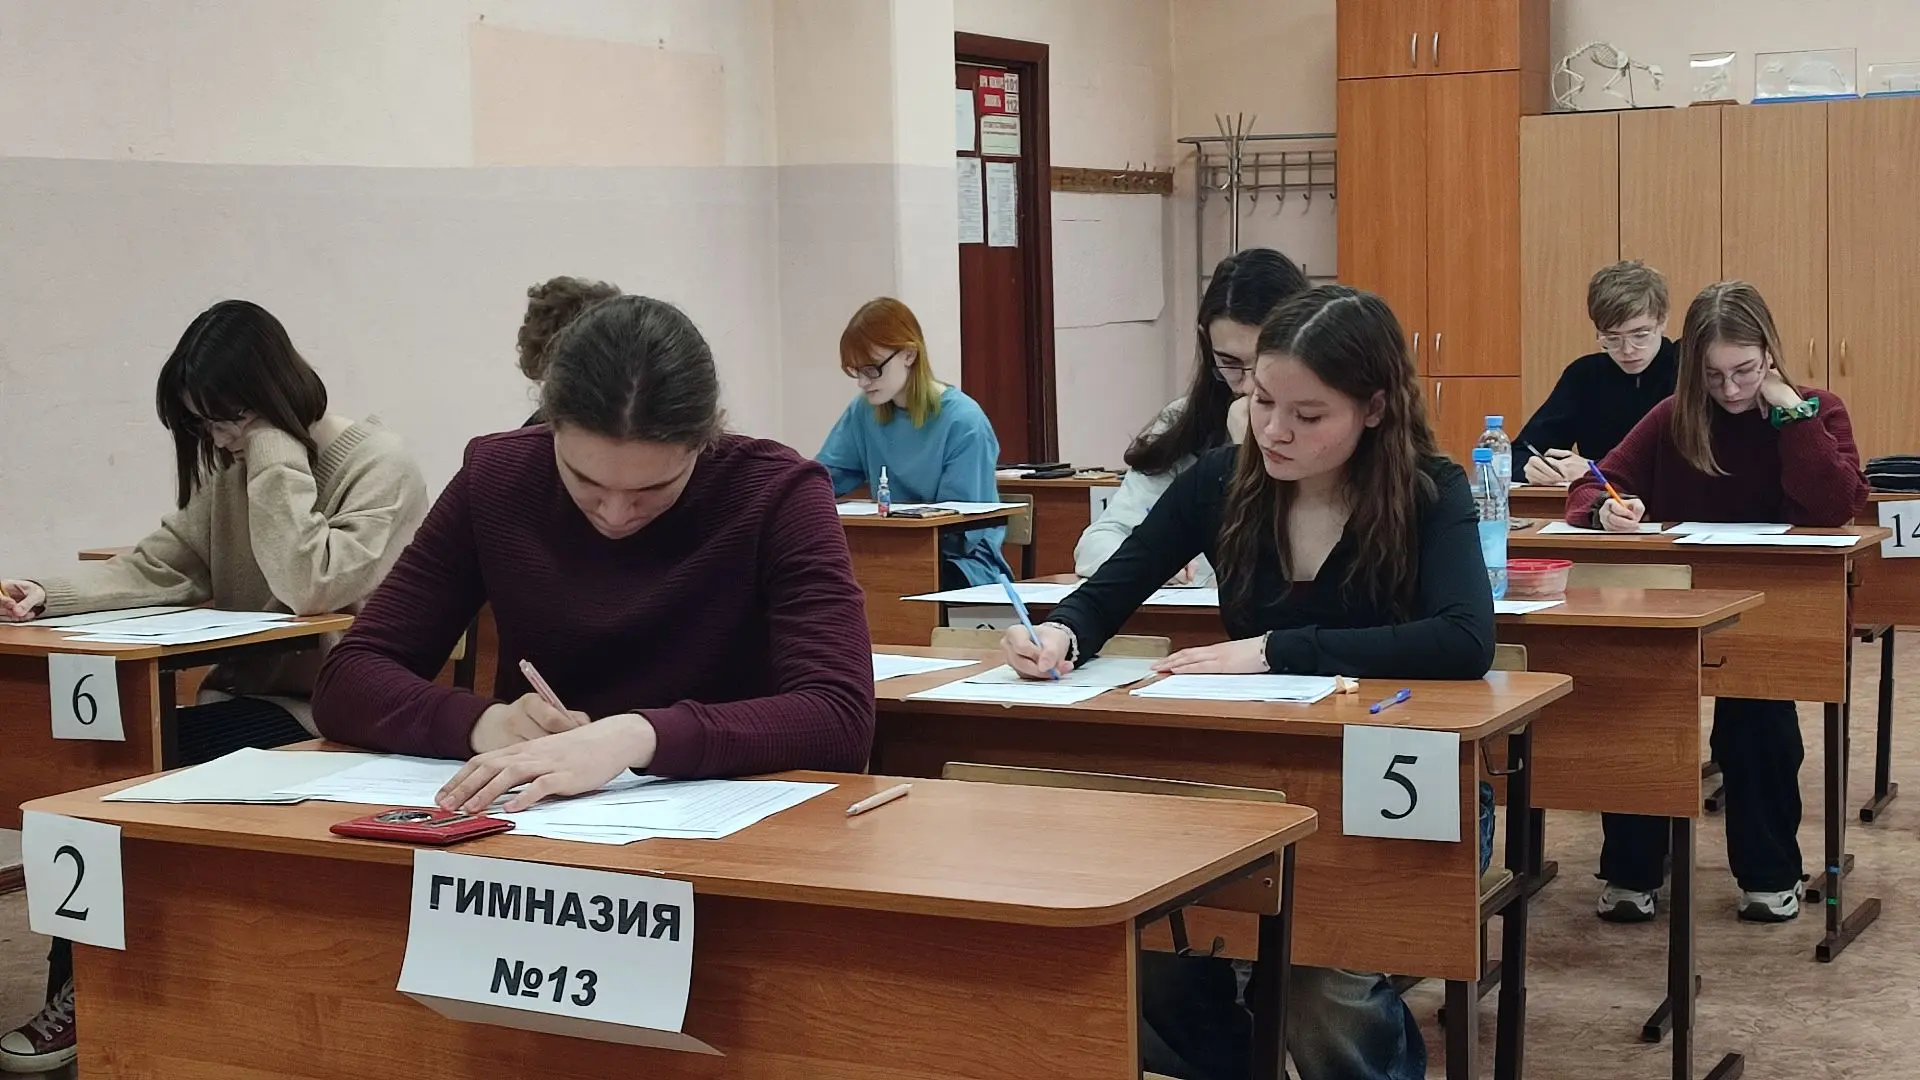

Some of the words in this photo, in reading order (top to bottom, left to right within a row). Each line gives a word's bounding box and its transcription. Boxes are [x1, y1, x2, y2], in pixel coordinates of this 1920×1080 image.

[1006, 99, 1018, 112] 112
[72, 673, 98, 726] 6
[1380, 754, 1418, 820] 5
[53, 844, 90, 921] 2
[429, 873, 681, 942] ГИМНАЗИЯ
[489, 957, 599, 1008] №13
